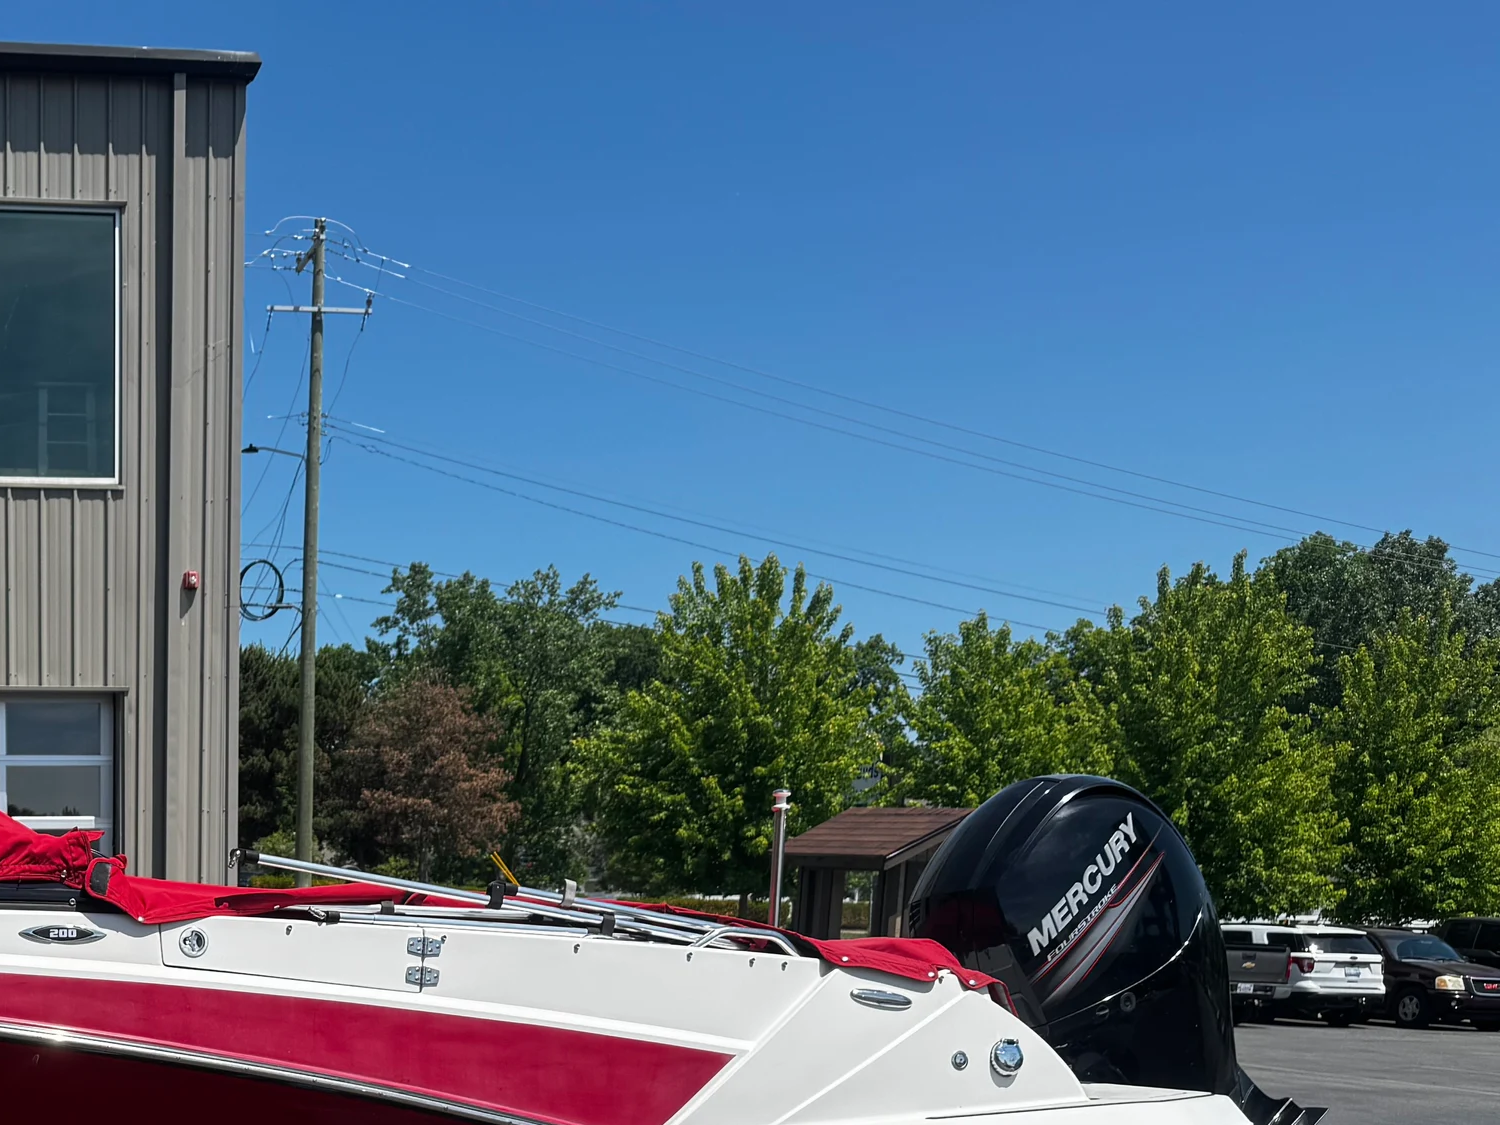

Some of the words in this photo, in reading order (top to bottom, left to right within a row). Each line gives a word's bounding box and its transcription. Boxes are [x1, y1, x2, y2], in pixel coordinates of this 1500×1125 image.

[1027, 811, 1137, 957] MERCURY
[1047, 884, 1118, 961] FOURSTROKE
[49, 928, 77, 938] 200
